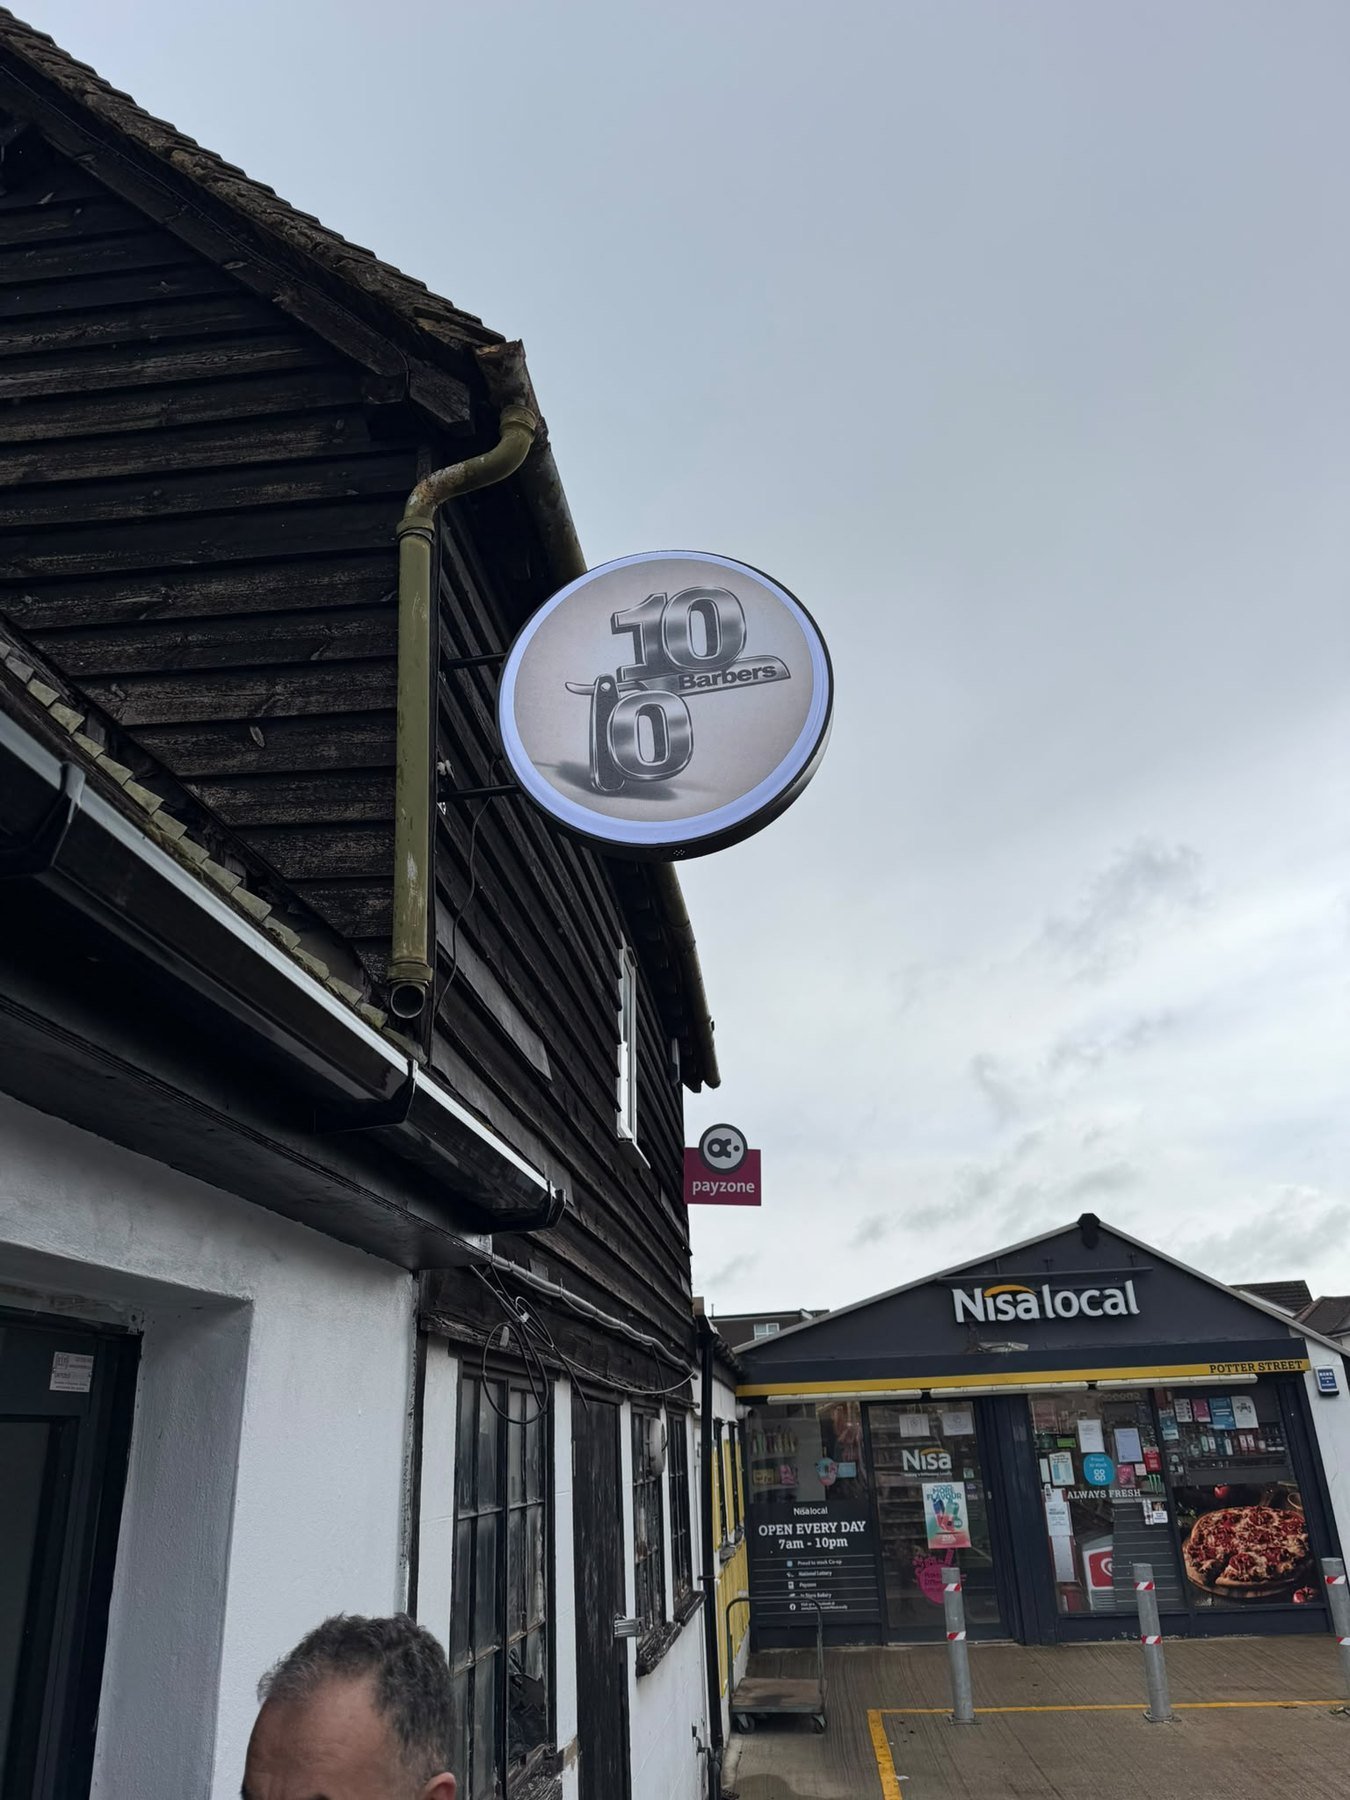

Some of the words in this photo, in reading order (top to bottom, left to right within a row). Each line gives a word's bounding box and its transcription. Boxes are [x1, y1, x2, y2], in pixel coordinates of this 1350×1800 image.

[610, 586, 747, 682] 10
[677, 663, 778, 691] Barbers
[692, 1181, 756, 1197] payzone
[1210, 1362, 1255, 1374] POTTER
[1258, 1360, 1303, 1371] STREET
[902, 1448, 952, 1471] Nisa
[926, 1492, 962, 1500] FLAVOUR
[1067, 1490, 1107, 1499] ALWAYS
[1108, 1489, 1141, 1498] FRESH
[758, 1524, 793, 1536] OPEN
[796, 1522, 838, 1534] EVERY
[840, 1521, 866, 1532] DAY
[778, 1539, 804, 1549] 7am
[815, 1537, 848, 1549] 10pm
